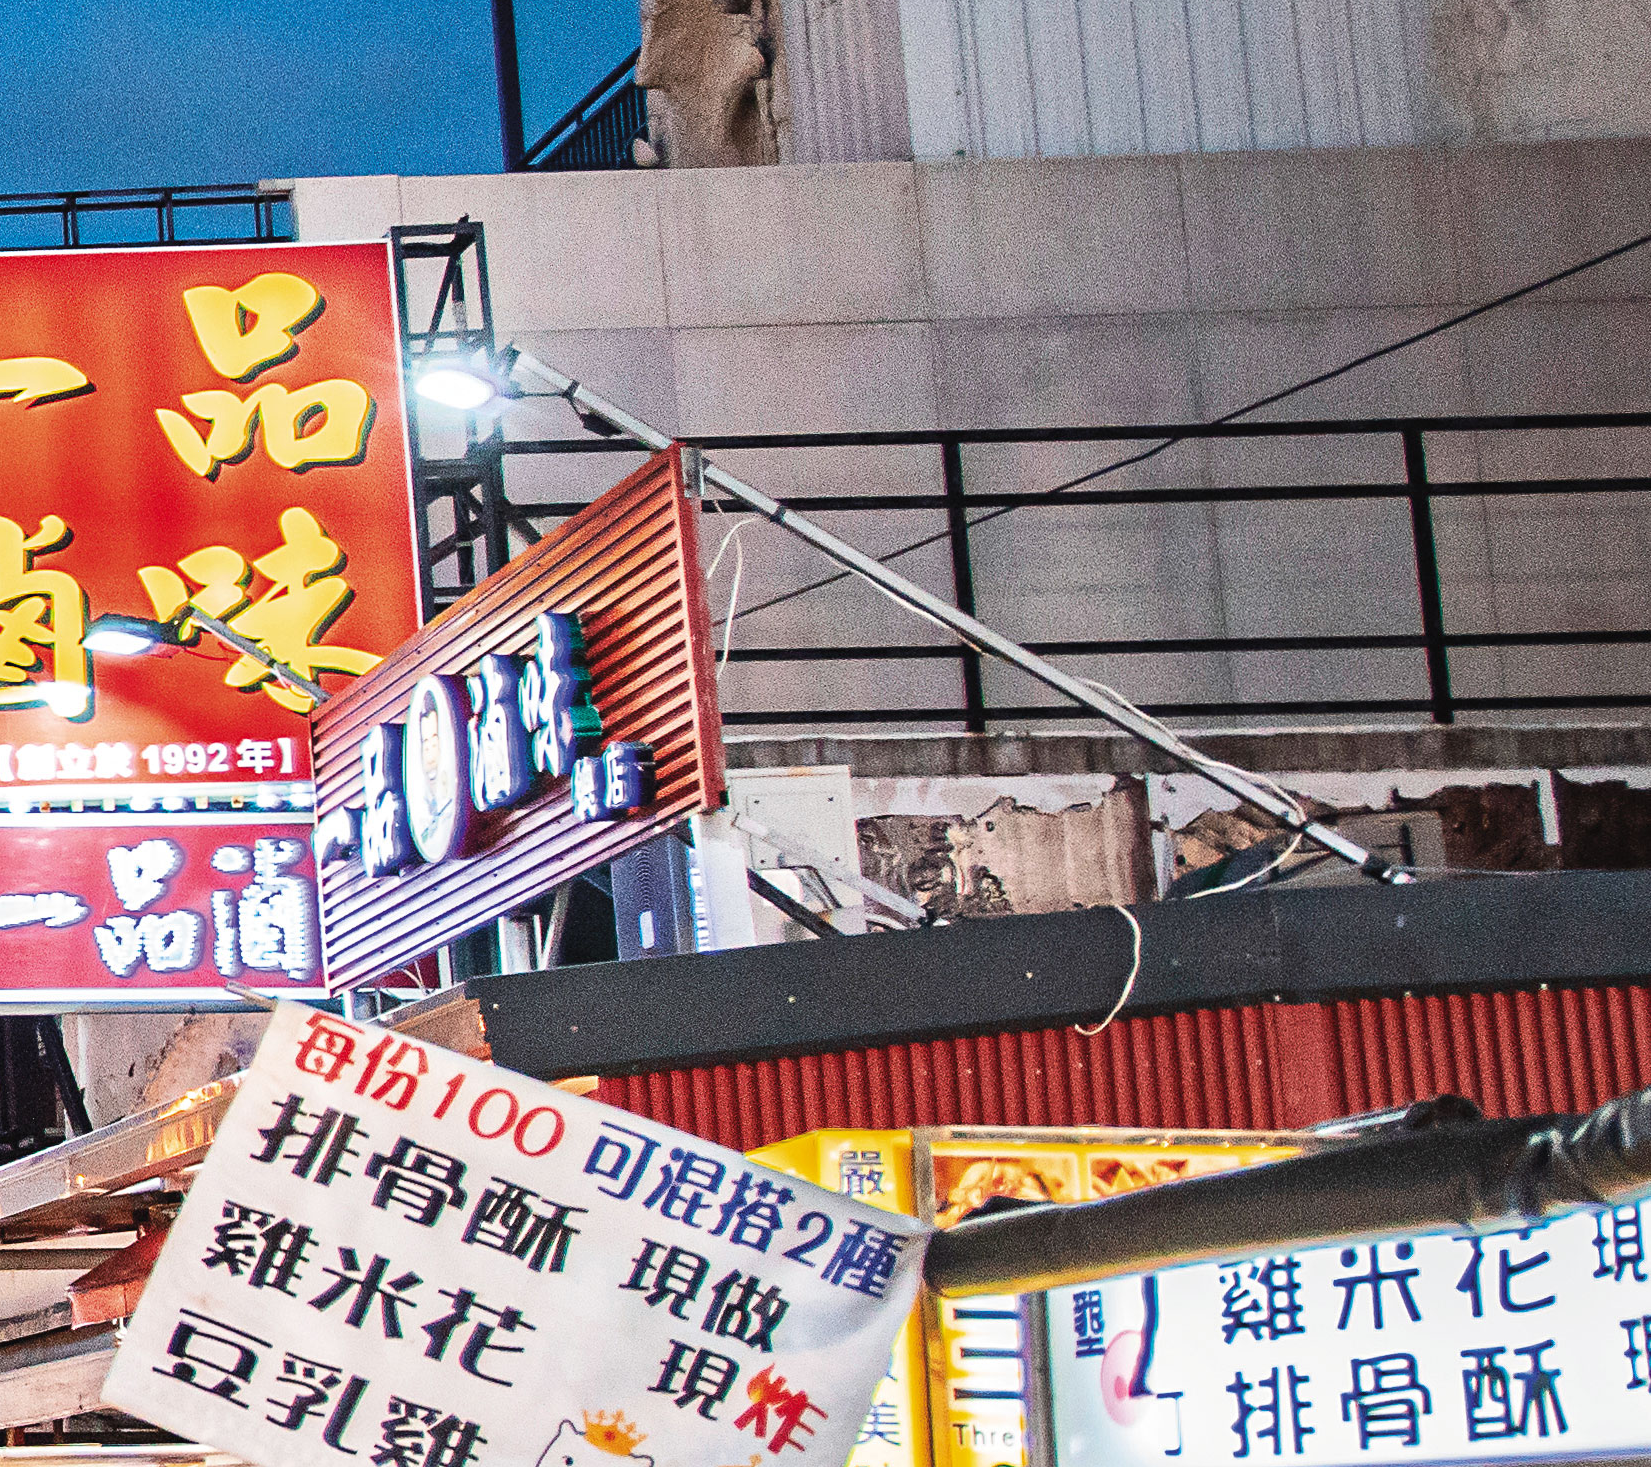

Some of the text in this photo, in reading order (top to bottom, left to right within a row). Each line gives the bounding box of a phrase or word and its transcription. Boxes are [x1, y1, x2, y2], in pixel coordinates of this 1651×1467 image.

[250, 1088, 610, 1282] 排骨酥
[644, 1334, 834, 1459] 現炸
[1226, 1340, 1570, 1459] 排骨酥
